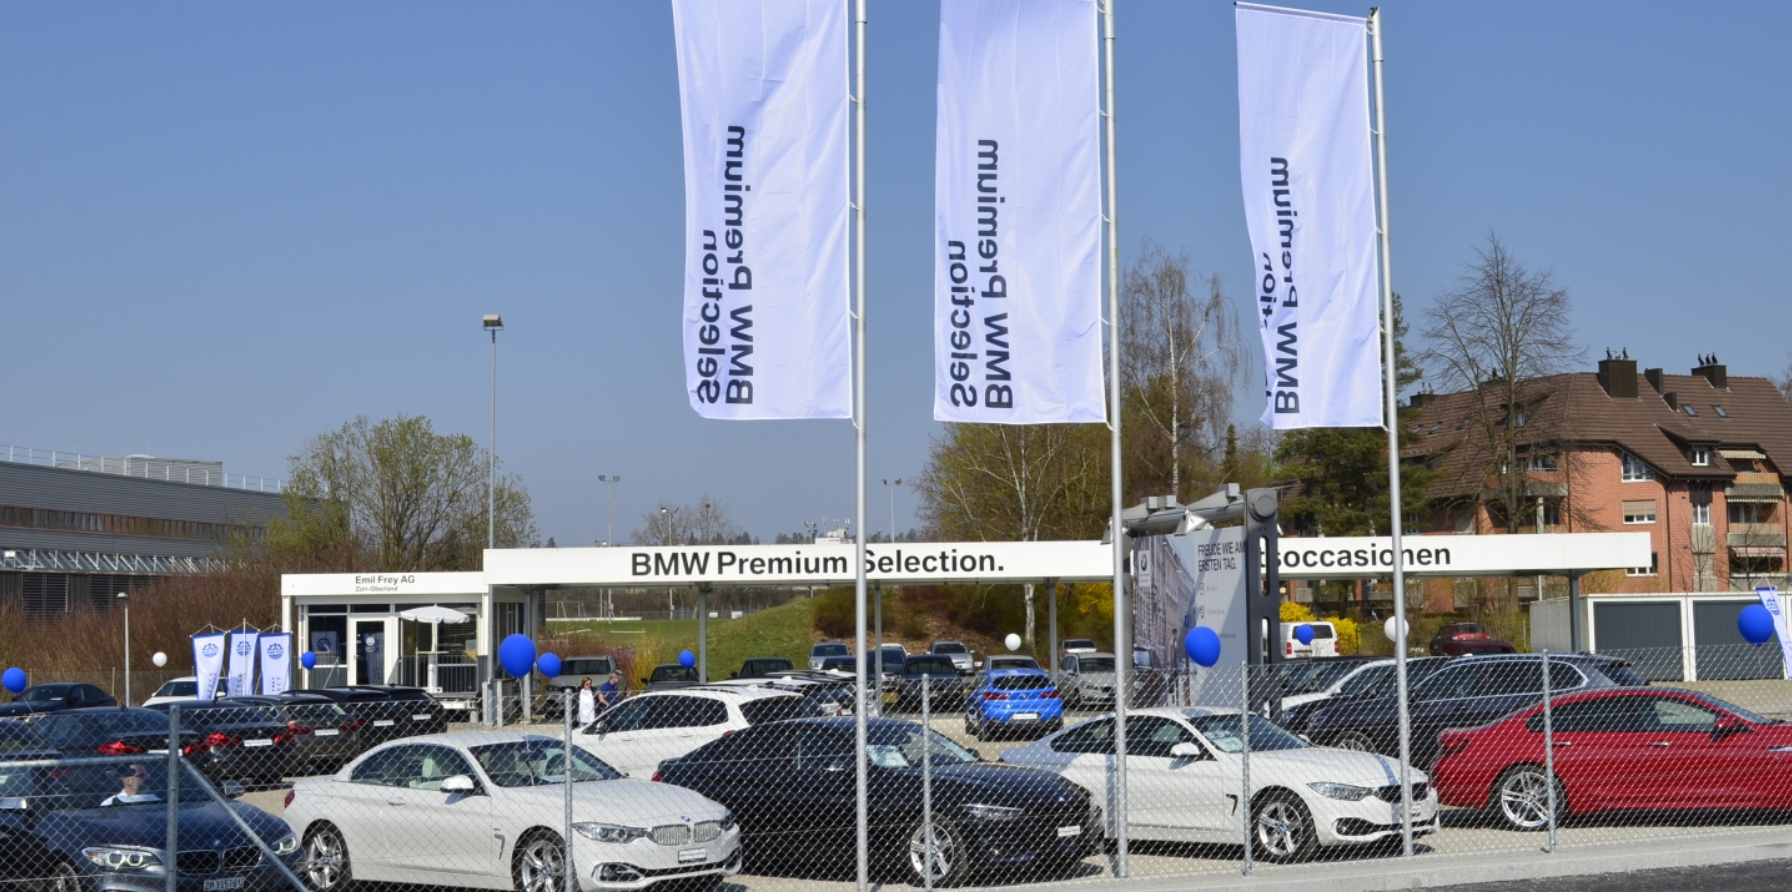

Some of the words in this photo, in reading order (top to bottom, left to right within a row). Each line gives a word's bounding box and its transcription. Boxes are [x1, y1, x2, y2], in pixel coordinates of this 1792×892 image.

[1198, 543, 1221, 556] FREUDE
[1222, 542, 1234, 554] WIE
[631, 551, 710, 576] BMW
[717, 550, 847, 575] Premium
[865, 548, 1004, 574] Selection.
[1198, 558, 1222, 572] ERSTEN
[355, 575, 376, 584] Emil
[377, 575, 399, 586] Frey
[400, 574, 416, 584] AG
